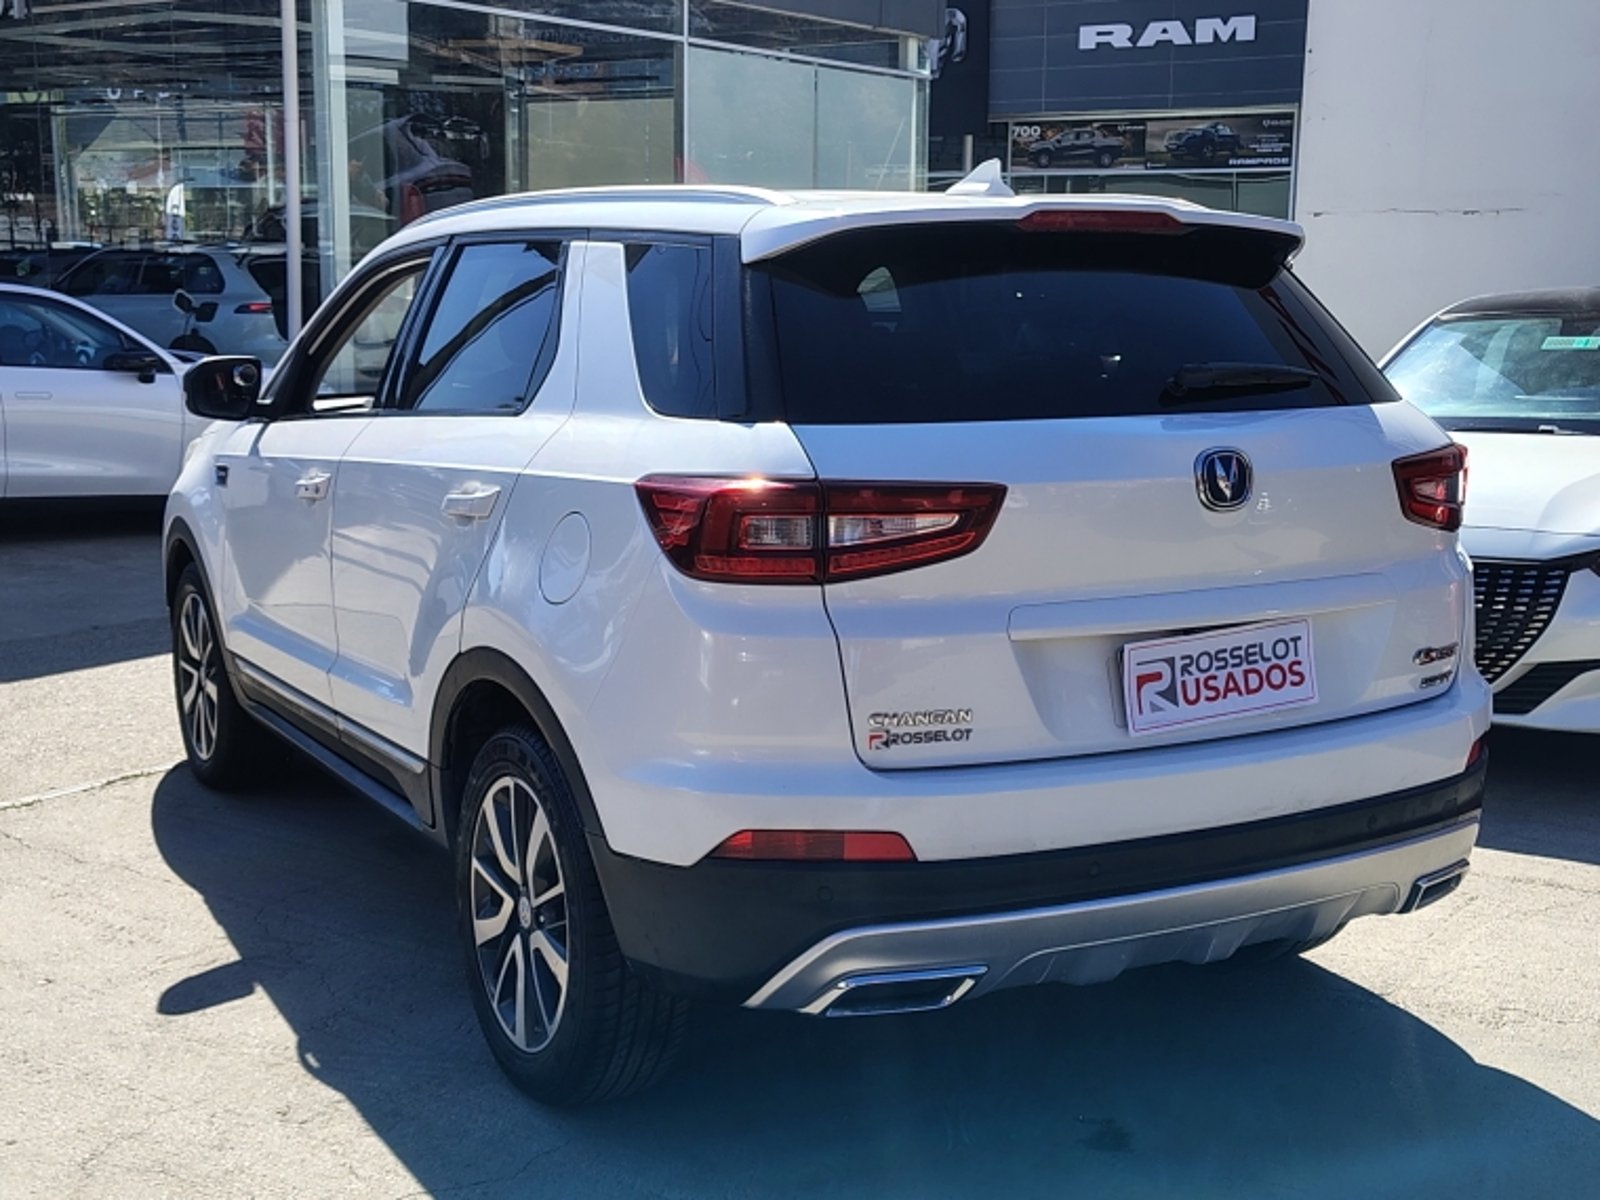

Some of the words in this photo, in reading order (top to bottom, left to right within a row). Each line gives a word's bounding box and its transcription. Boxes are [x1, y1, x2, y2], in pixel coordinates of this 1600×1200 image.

[1078, 14, 1256, 50] RAM
[1012, 125, 1041, 138] 700
[1180, 635, 1302, 678] ROSSELOT
[1181, 660, 1306, 706] USADOS
[868, 708, 973, 727] CHANGAN
[890, 728, 973, 746] ROSSELOT
